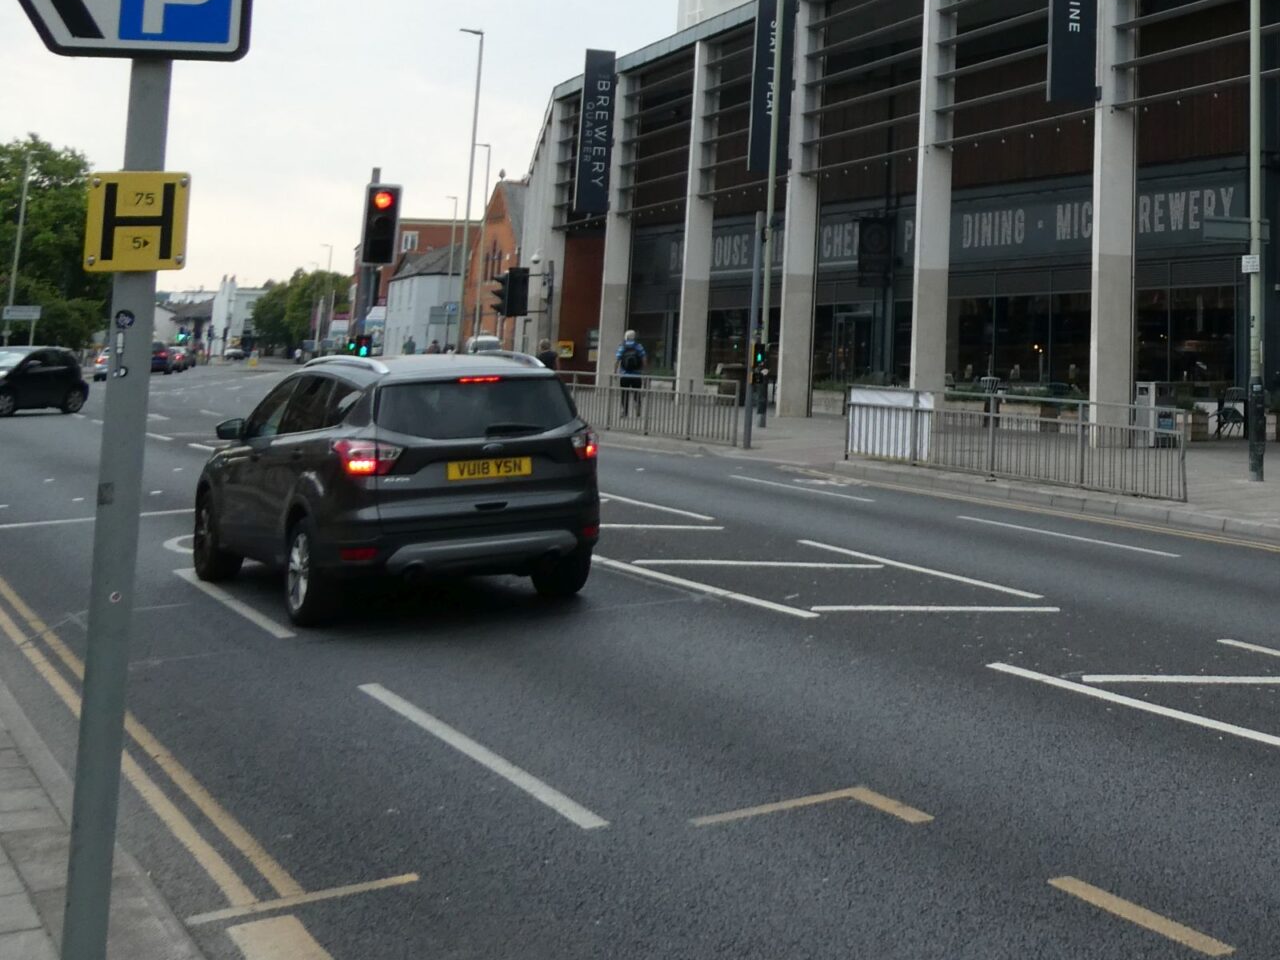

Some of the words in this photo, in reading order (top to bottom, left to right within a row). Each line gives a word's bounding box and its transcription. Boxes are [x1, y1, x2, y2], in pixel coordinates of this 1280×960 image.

[583, 101, 596, 162] QUARTER
[592, 81, 611, 187] BREWERY
[100, 182, 176, 261] H
[134, 192, 155, 206] 75
[961, 208, 1025, 249] DINING
[1056, 187, 1235, 241] MICREWERY
[131, 236, 142, 250] 5
[459, 461, 490, 477] VU18
[494, 459, 522, 474] YSN
